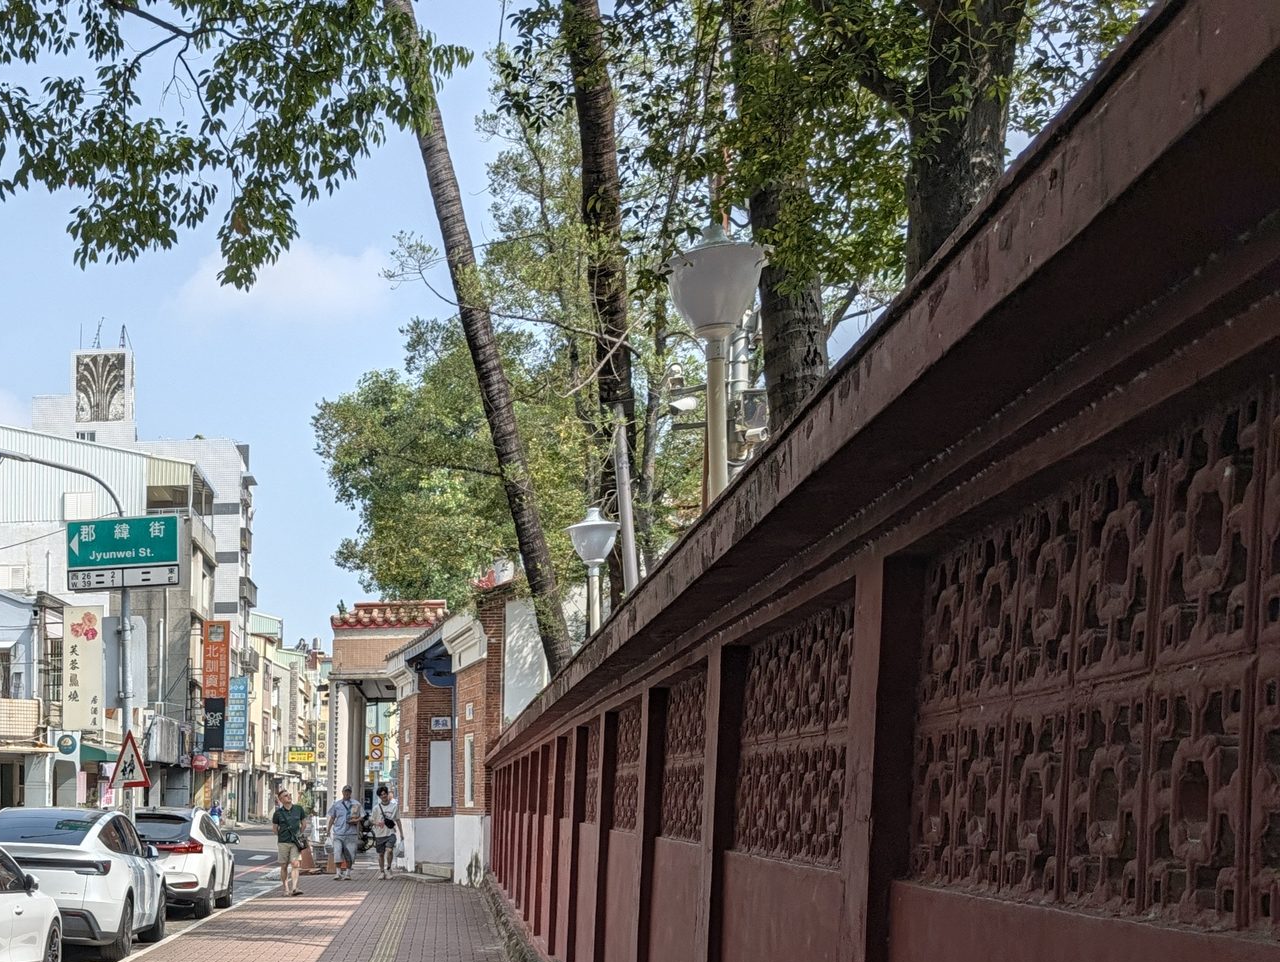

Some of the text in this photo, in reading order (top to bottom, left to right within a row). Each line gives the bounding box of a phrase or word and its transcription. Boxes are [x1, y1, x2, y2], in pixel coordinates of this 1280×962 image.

[80, 521, 165, 542] 郡緯街
[89, 547, 155, 561] Jyunwei St.
[82, 572, 92, 580] 26
[306, 752, 313, 761] P
